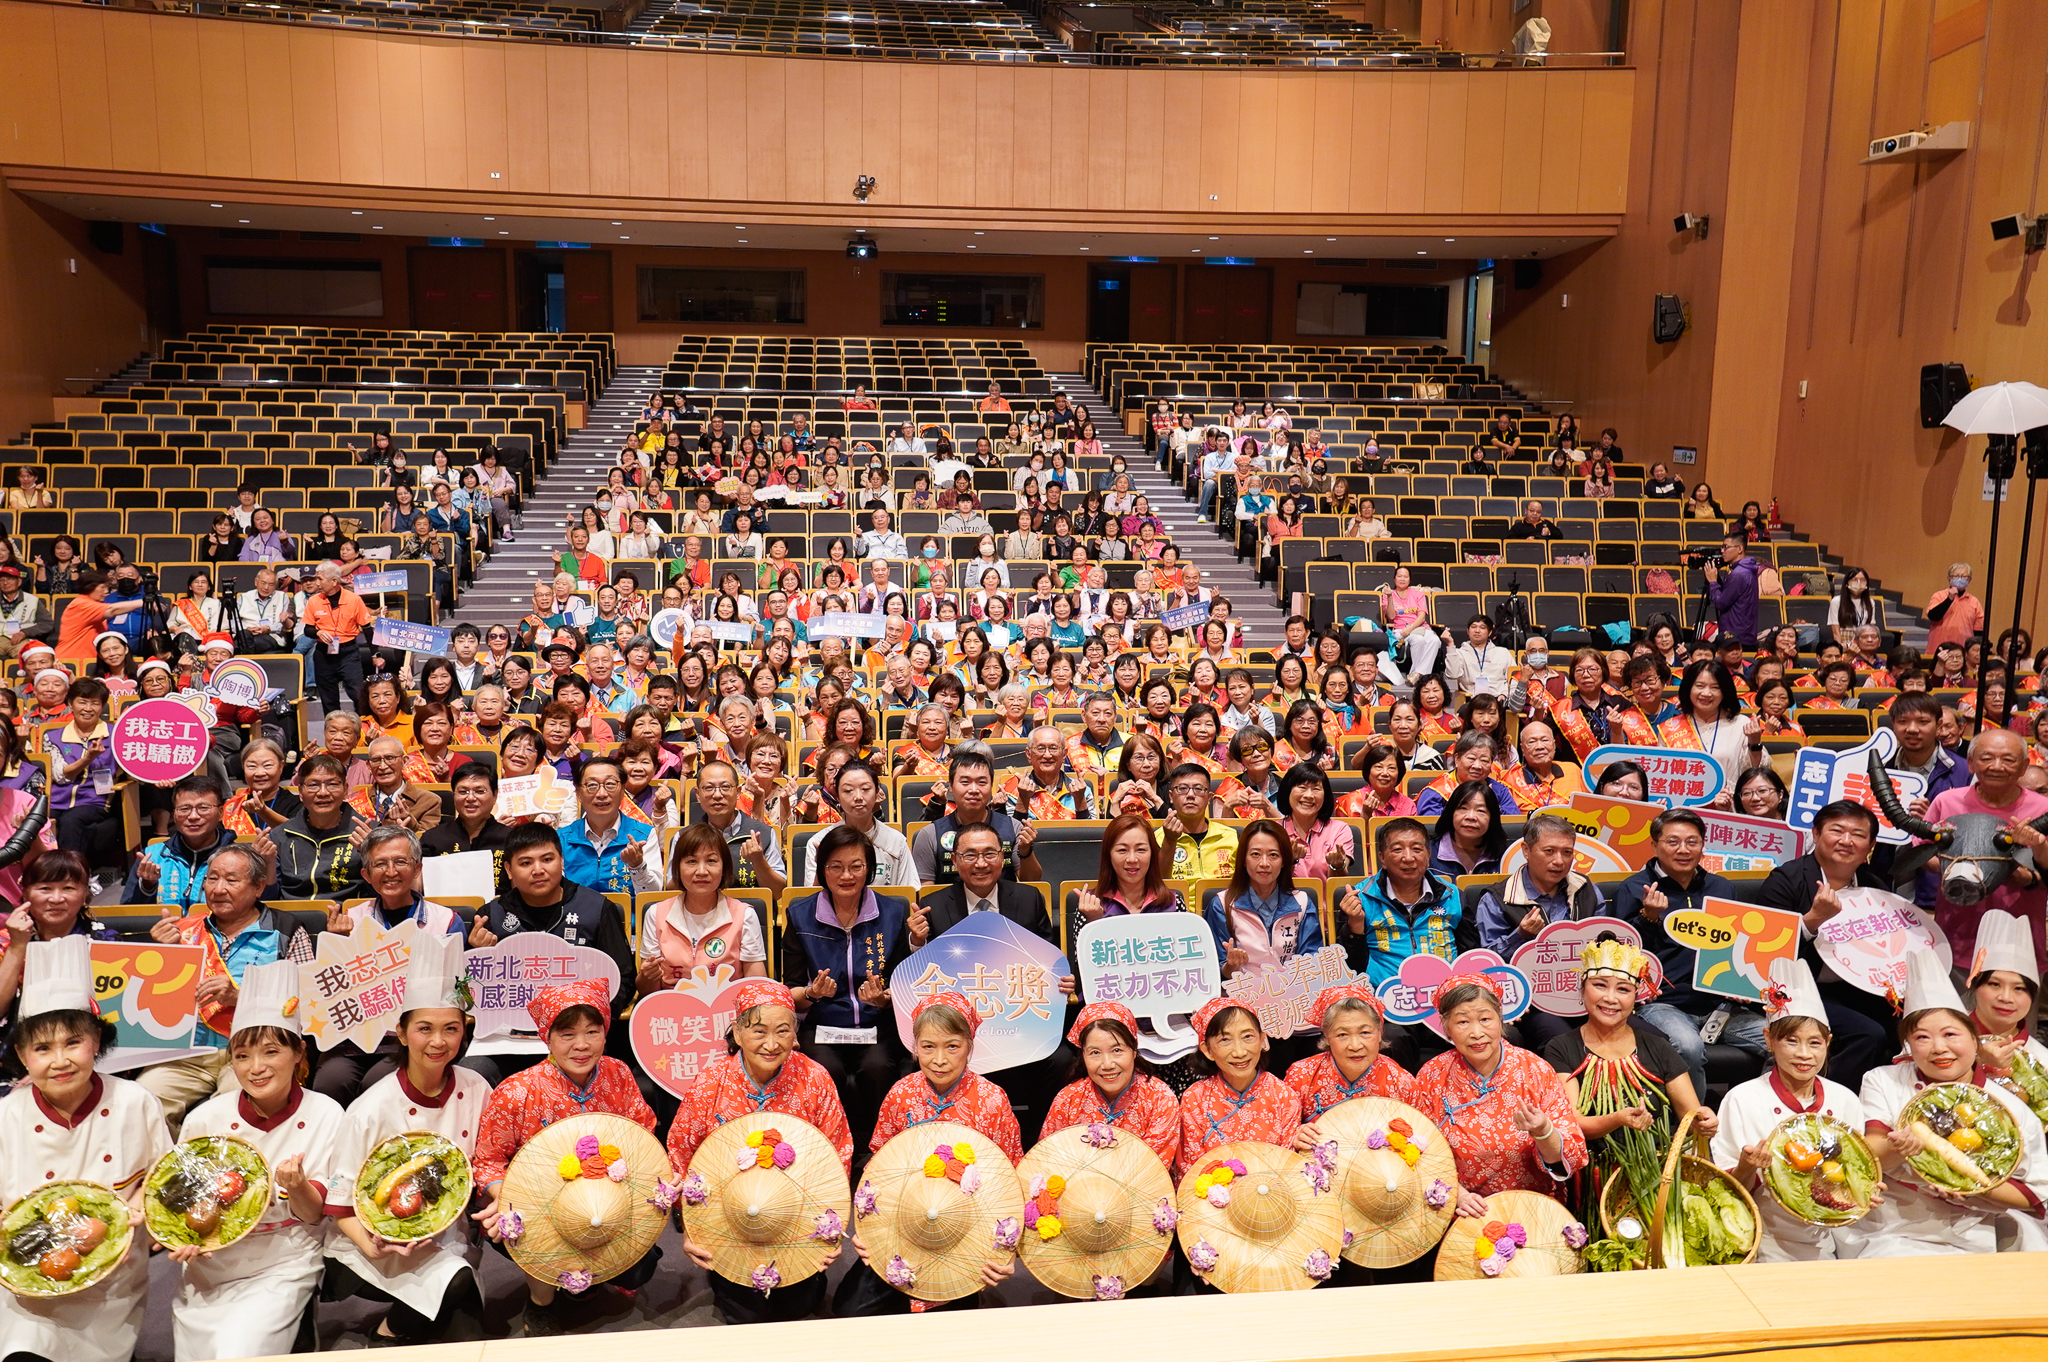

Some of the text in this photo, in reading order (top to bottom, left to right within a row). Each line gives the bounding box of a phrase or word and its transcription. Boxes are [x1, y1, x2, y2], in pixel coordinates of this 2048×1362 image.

[220, 678, 252, 699] 陶博
[125, 717, 199, 741] 我志工
[1568, 723, 1585, 735] 2025
[1630, 730, 1648, 739] 2025
[1670, 729, 1688, 741] 2025
[122, 741, 197, 765] 我驕傲
[1634, 756, 1706, 776] 志力傳承
[498, 780, 538, 805] 莊志工
[1796, 760, 1829, 811] 志工
[1672, 917, 1732, 945] let's go
[1822, 908, 1920, 943] 志在新北
[1091, 935, 1204, 966] 新北志工
[1535, 935, 1634, 966] 志工
[314, 941, 410, 997] 我志工
[467, 955, 577, 980] 新北志工
[1225, 946, 1354, 1004] 志心奉獻
[94, 975, 124, 993] go
[1094, 967, 1210, 999] 志力不凡
[1531, 969, 1578, 994] 溫暖
[989, 1026, 1019, 1036] Love!
